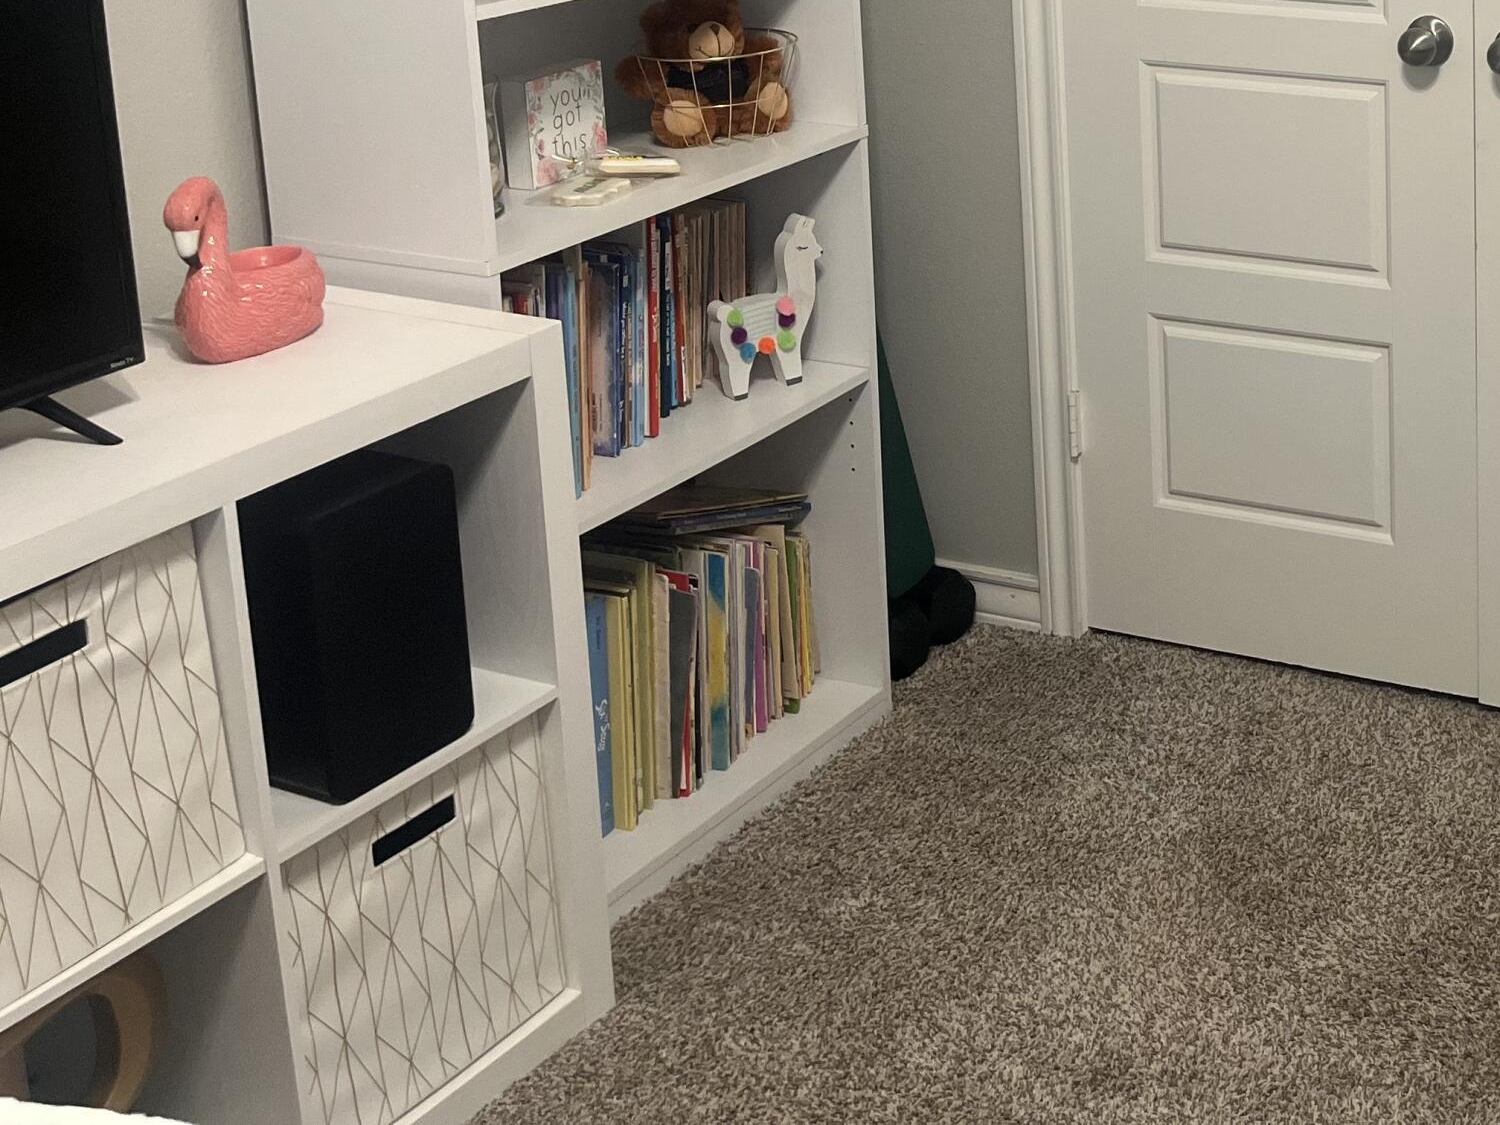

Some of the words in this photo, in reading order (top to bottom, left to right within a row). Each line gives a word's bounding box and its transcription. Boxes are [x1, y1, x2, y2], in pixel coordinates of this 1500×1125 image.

[550, 87, 582, 116] you
[553, 103, 582, 136] got
[552, 133, 587, 159] this
